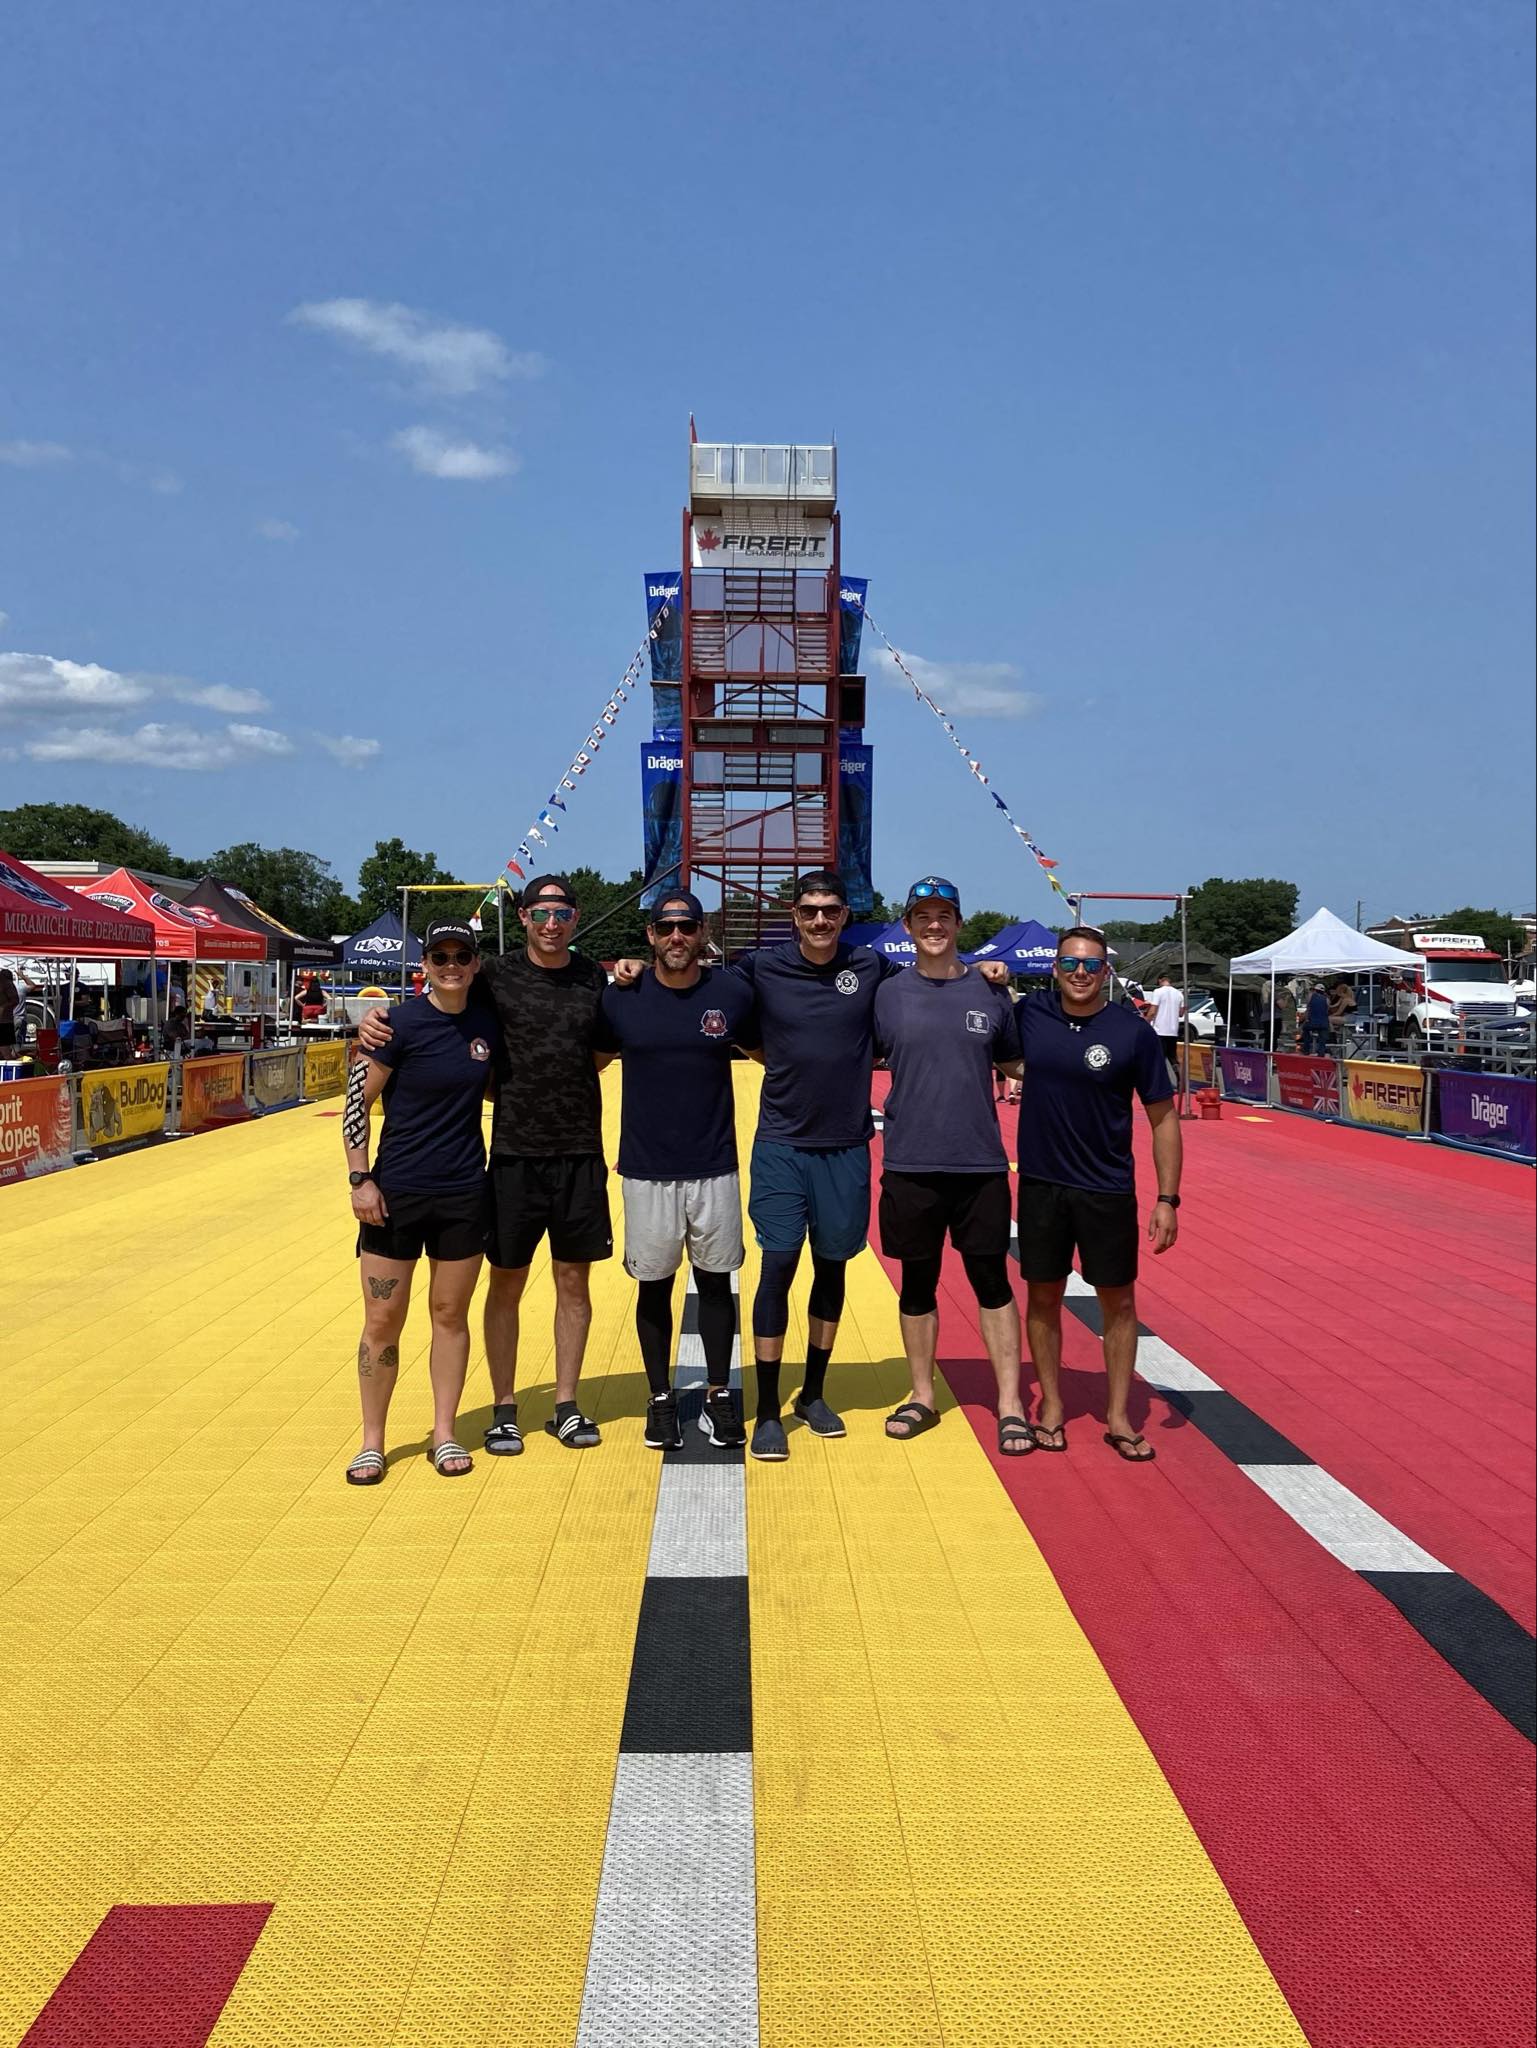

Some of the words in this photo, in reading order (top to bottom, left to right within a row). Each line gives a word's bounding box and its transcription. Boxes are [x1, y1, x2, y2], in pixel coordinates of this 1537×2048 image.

[722, 534, 826, 551] FIREFIT
[745, 550, 825, 558] CHAMPIONSHIPS
[649, 585, 679, 598] Dräger
[4, 912, 69, 937] MIRAMICHI
[71, 918, 94, 939] FIRE
[95, 921, 152, 944] DEPARTMENT
[432, 925, 471, 935] BAUER
[884, 941, 917, 954] Dräg
[1431, 936, 1478, 945] FIREFIT
[120, 1078, 165, 1109] BullDog
[1364, 1080, 1422, 1107] FIREFIT
[1471, 1093, 1510, 1129] Dräger
